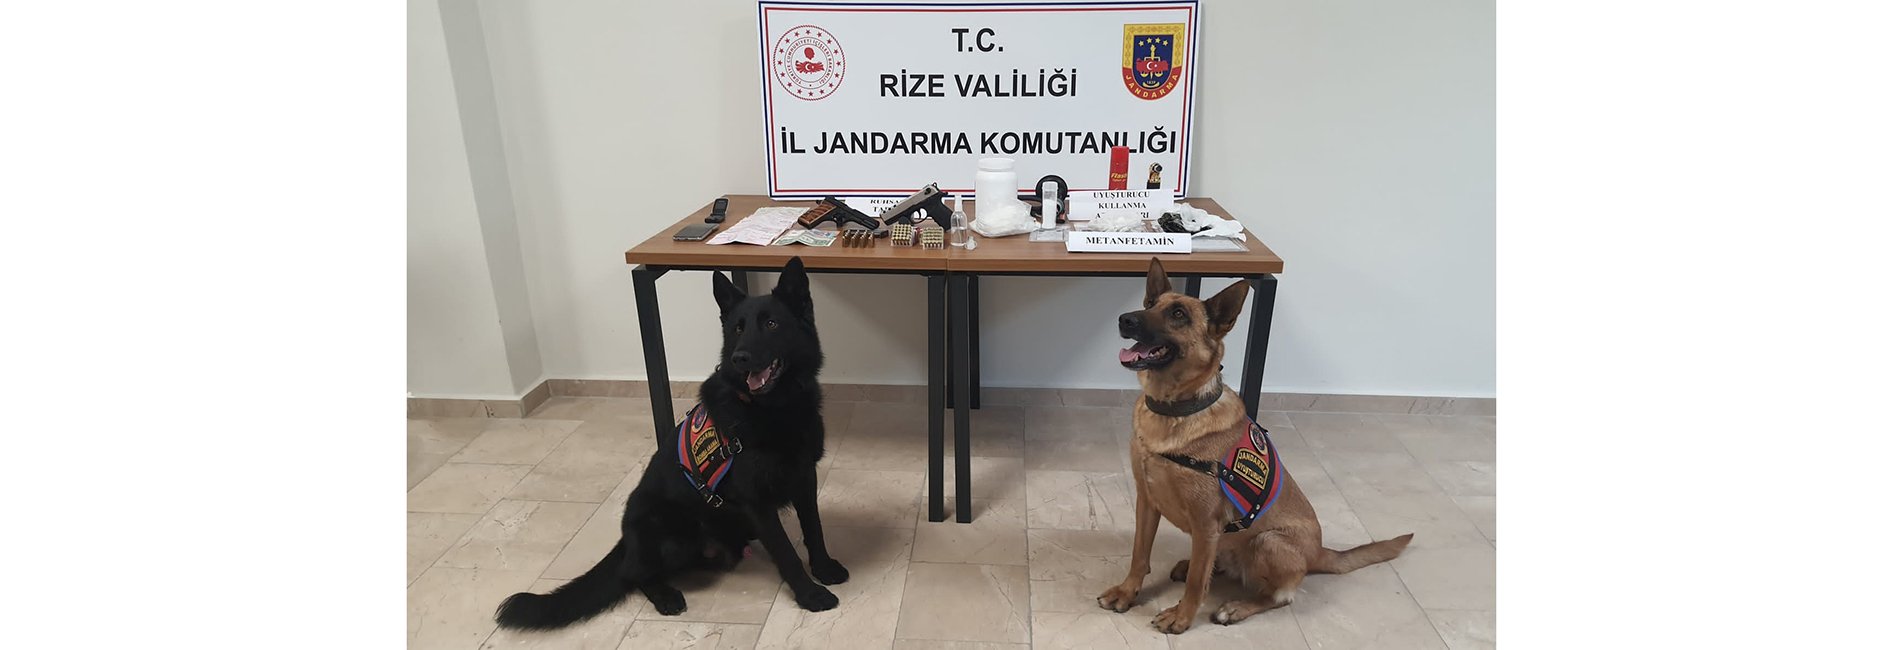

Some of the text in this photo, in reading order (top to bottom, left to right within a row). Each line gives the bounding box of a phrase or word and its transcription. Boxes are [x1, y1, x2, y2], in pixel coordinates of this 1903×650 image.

[951, 28, 1003, 52] T.C.
[880, 68, 1077, 97] RİZE VALİLİĞİ
[1125, 74, 1178, 98] JANDARMA
[781, 125, 1176, 154] İL JANDARMA KOMUTANLIĞI
[1093, 191, 1150, 199] UYUŞTURUCU
[1086, 236, 1175, 246] METANFETAMİN
[1238, 451, 1266, 476] JANDARMA
